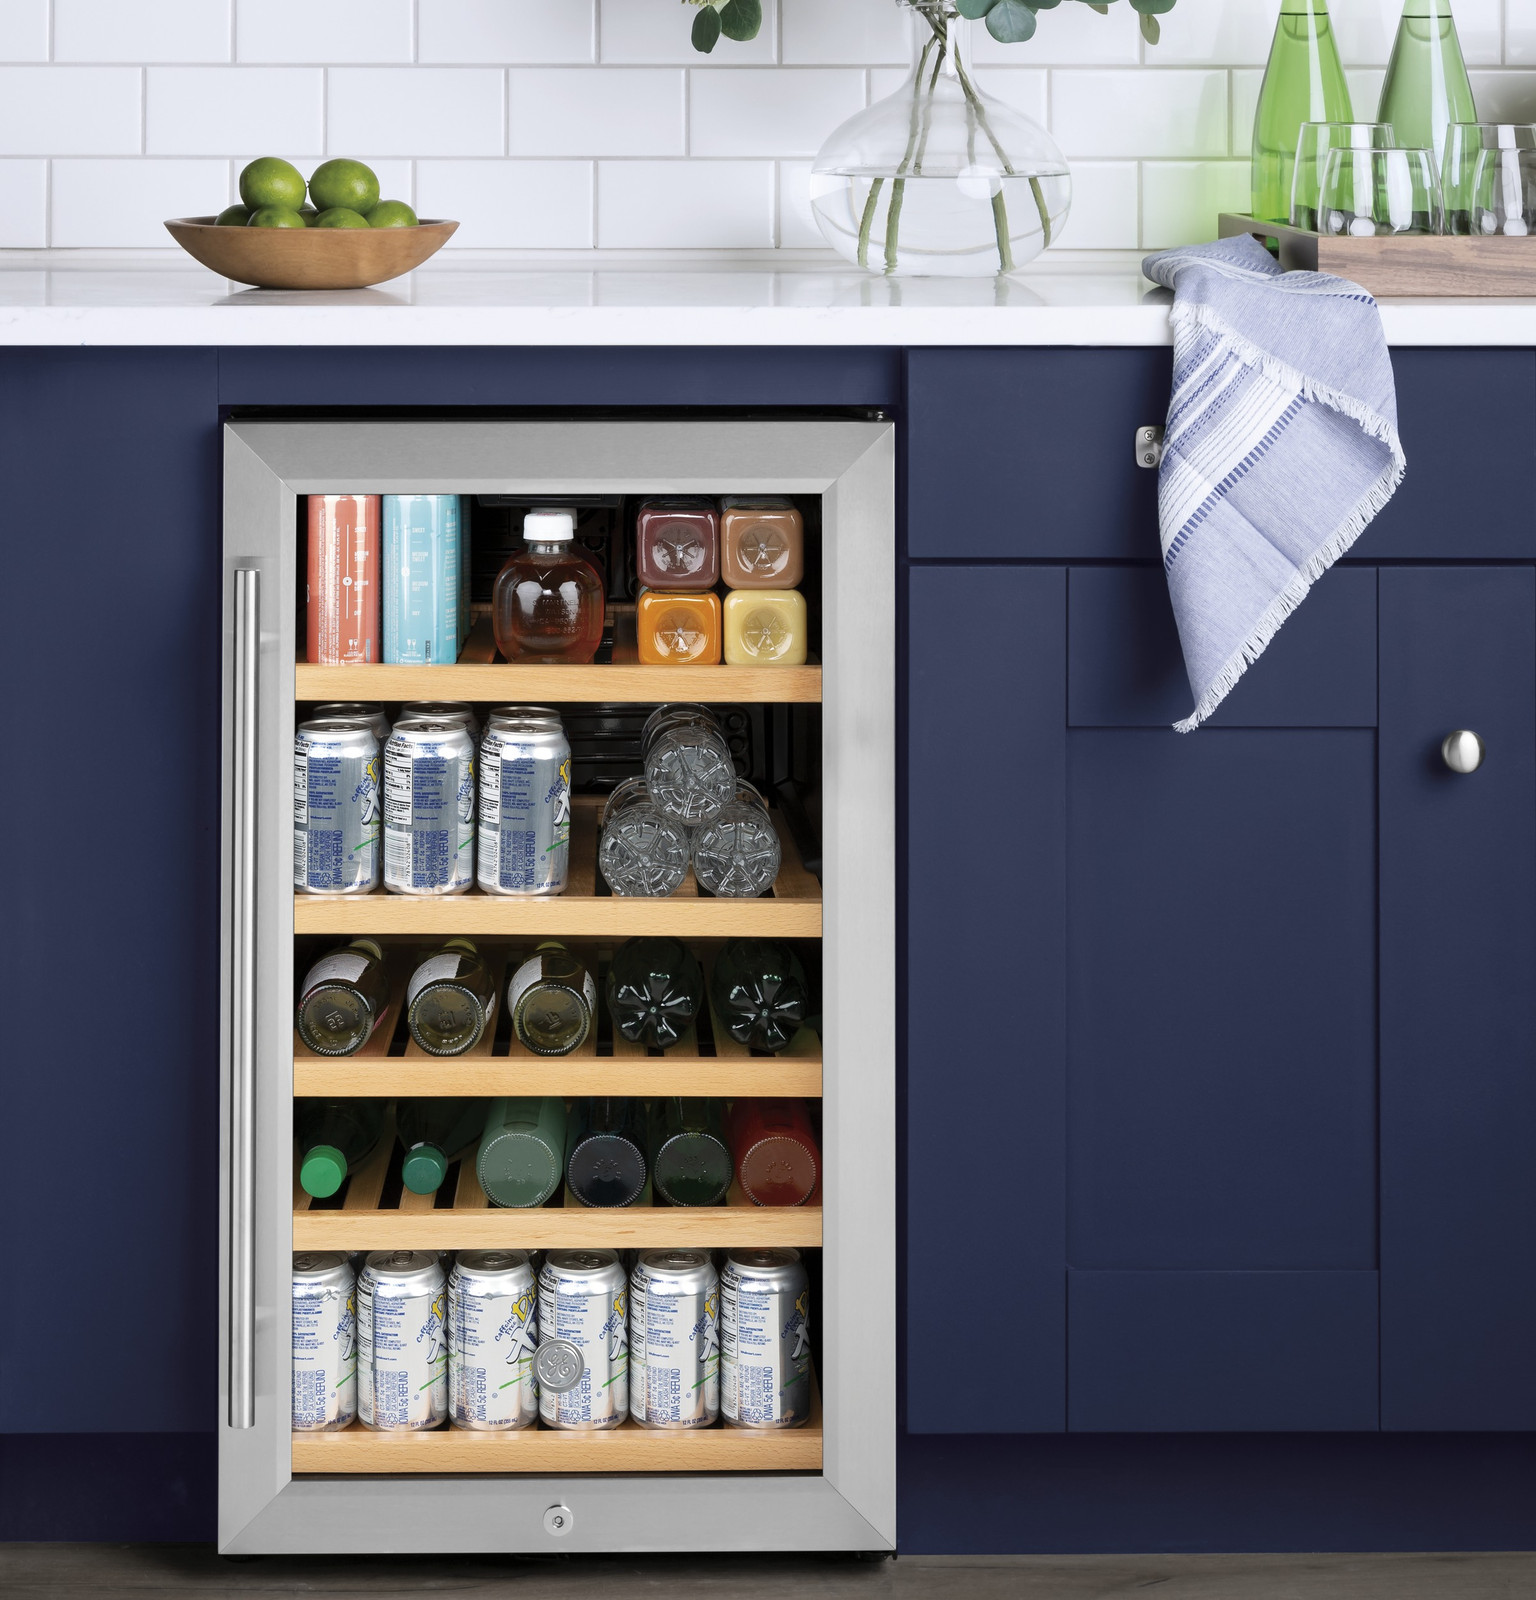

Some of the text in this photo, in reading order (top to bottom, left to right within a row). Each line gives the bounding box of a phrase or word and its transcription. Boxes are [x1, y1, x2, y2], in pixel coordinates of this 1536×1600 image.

[333, 830, 342, 856] REFUND
[439, 830, 448, 855] REFUND
[525, 831, 535, 857] REFUND
[316, 1370, 325, 1396] REFUND
[399, 1371, 408, 1397] REFUND
[477, 1368, 486, 1393] REFUND
[581, 1368, 591, 1394] REFUND
[671, 1369, 680, 1394] REFUND
[764, 1367, 773, 1392] REFUND
